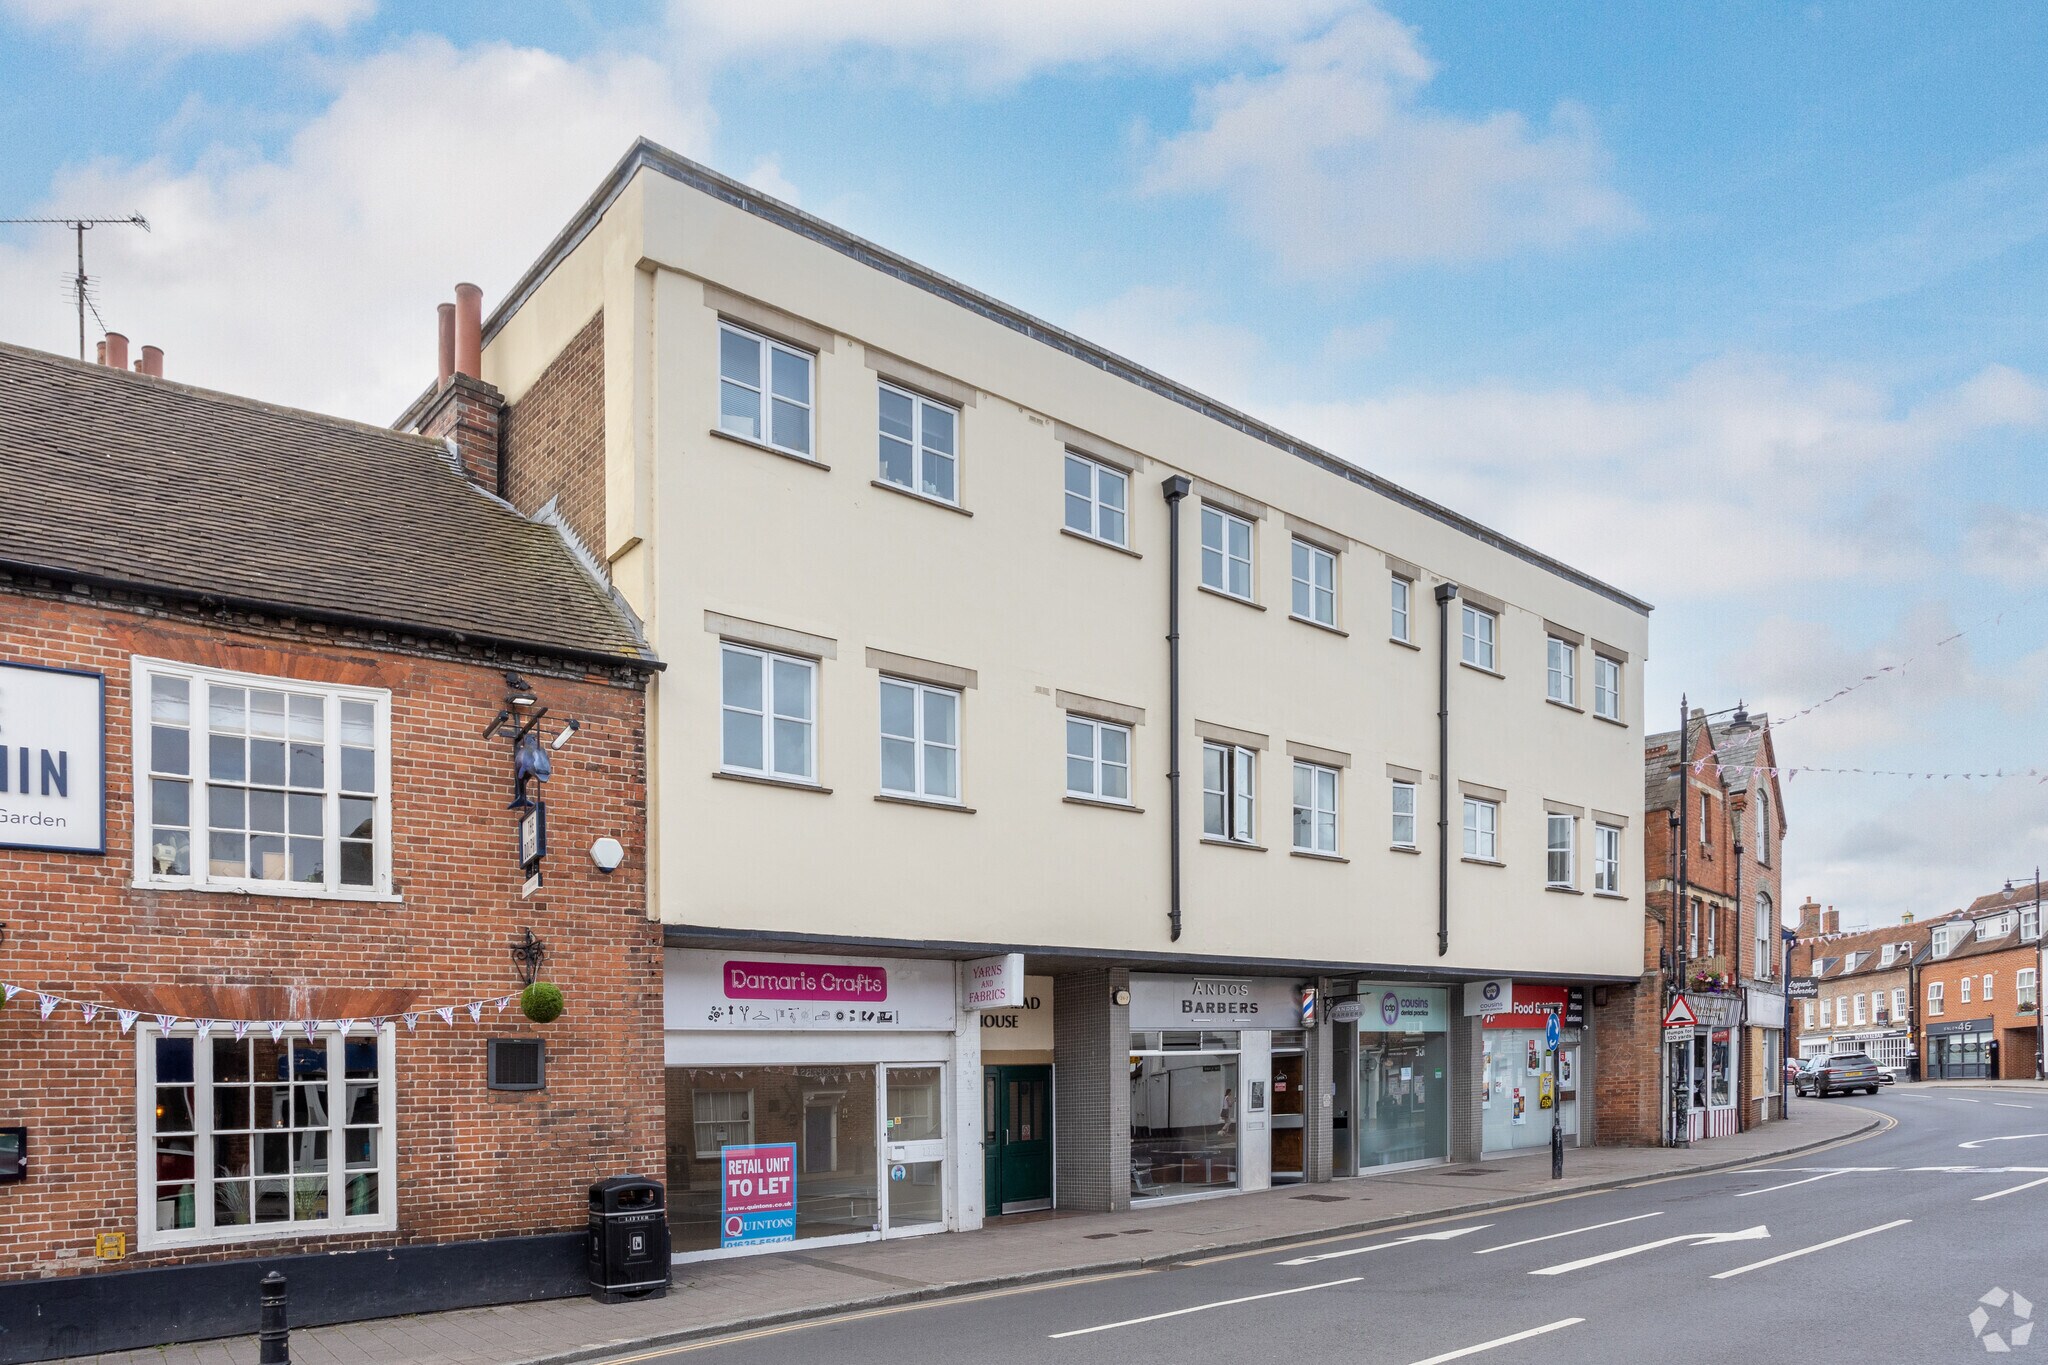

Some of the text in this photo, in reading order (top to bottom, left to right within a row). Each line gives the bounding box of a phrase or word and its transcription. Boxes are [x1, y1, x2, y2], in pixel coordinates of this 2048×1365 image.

[973, 964, 1002, 979] YARNS
[731, 969, 882, 996] Damaris Crafts
[981, 980, 994, 988] AND
[1192, 981, 1249, 996] ANDOS
[969, 988, 1006, 1003] FABRICS
[1181, 1000, 1259, 1014] BARBERS
[1384, 1003, 1396, 1013] cdp
[1400, 997, 1429, 1008] cousins
[1513, 1002, 1534, 1014] Food
[1331, 1011, 1363, 1019] BARBERS
[1958, 1022, 1972, 1031] 46
[1677, 1033, 1692, 1041] yards
[728, 1157, 790, 1175] RETAIL UNIT
[728, 1176, 790, 1197] TO LET
[727, 1201, 792, 1211] www.quintons.co.uk
[725, 1216, 793, 1237] QUINTONS
